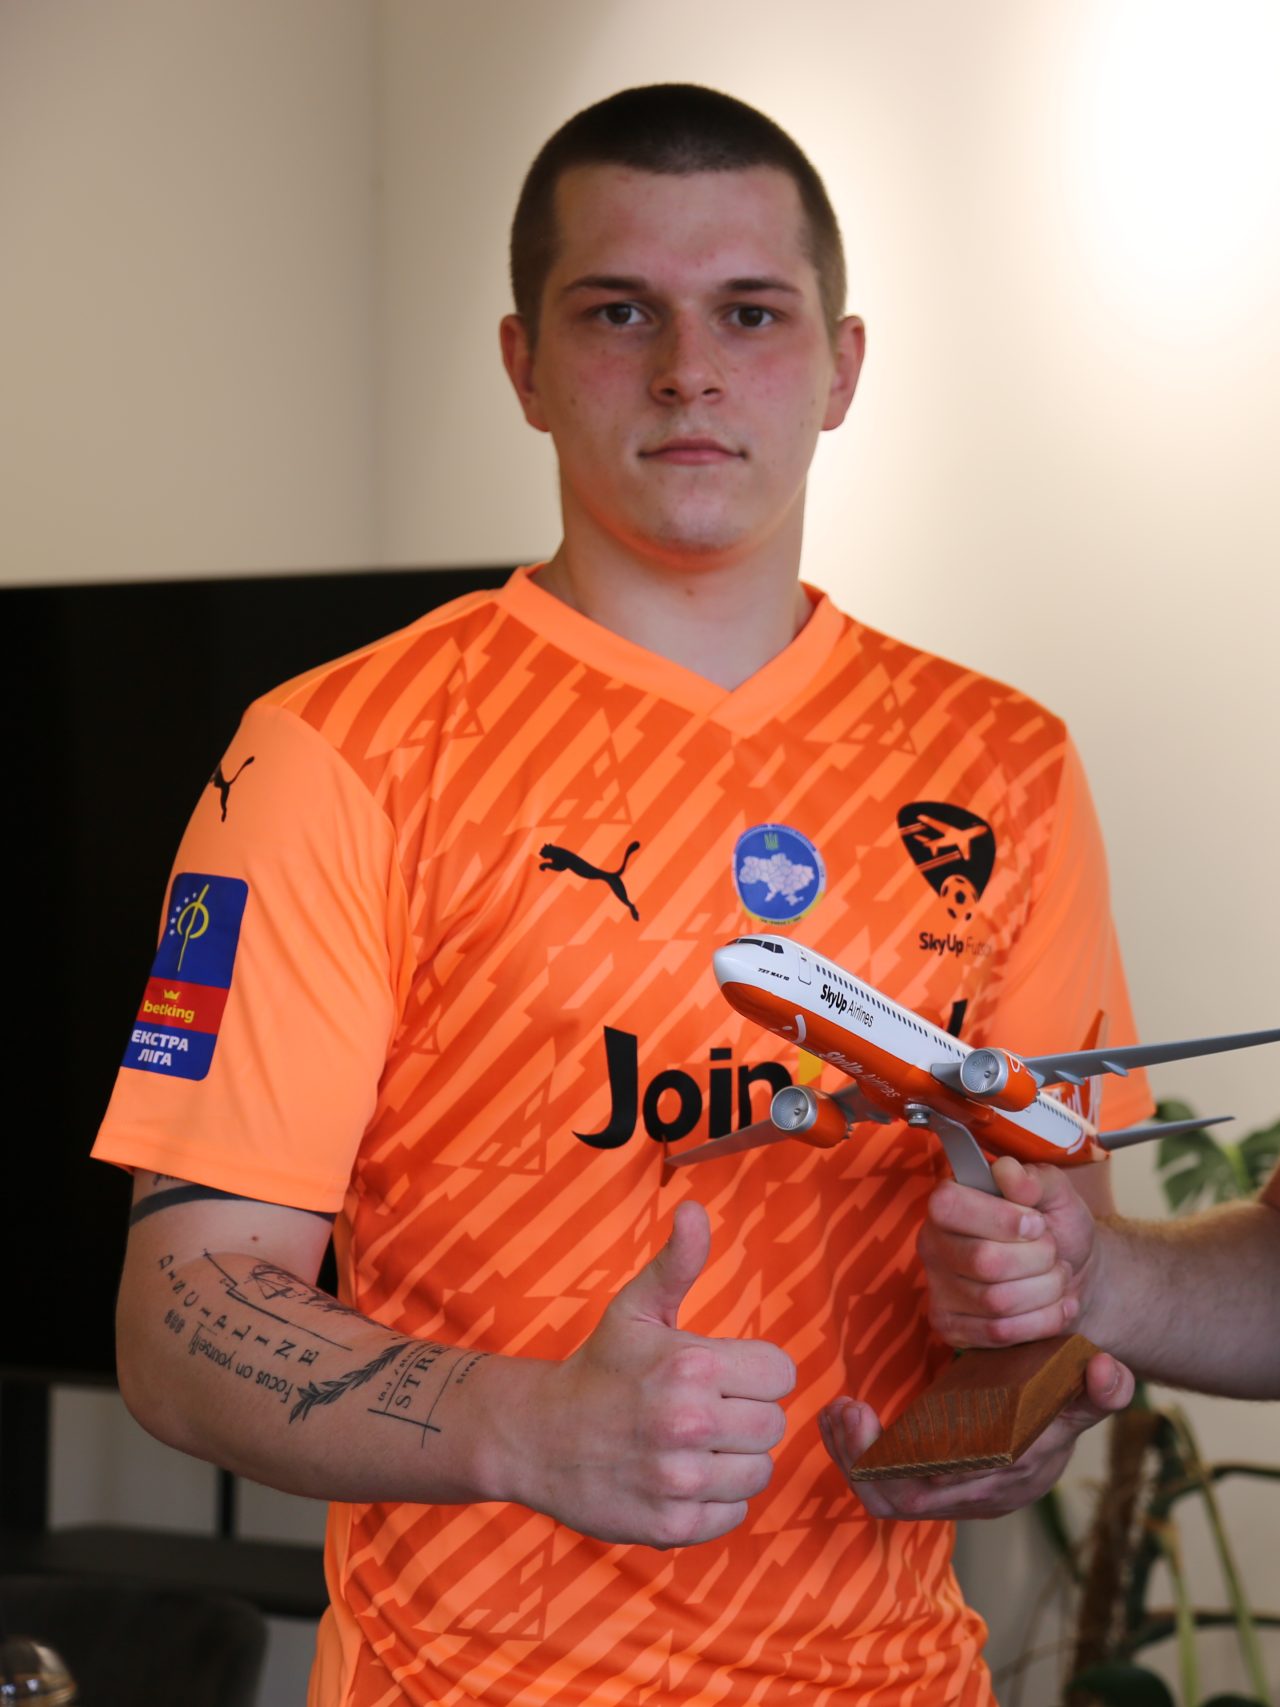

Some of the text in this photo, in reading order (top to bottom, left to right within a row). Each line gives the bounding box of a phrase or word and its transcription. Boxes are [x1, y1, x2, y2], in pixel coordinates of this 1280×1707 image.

[919, 931, 964, 958] SkyUp
[143, 1000, 195, 1024] betking
[820, 984, 875, 1028] SkyUp Airlines
[131, 1029, 189, 1052] ЕКСТРА
[138, 1049, 172, 1067] ЛІГА
[572, 1025, 793, 1150] Join
[158, 1254, 319, 1367] DISCIPLINE
[235, 1363, 253, 1379] on
[255, 1371, 294, 1404] Focus
